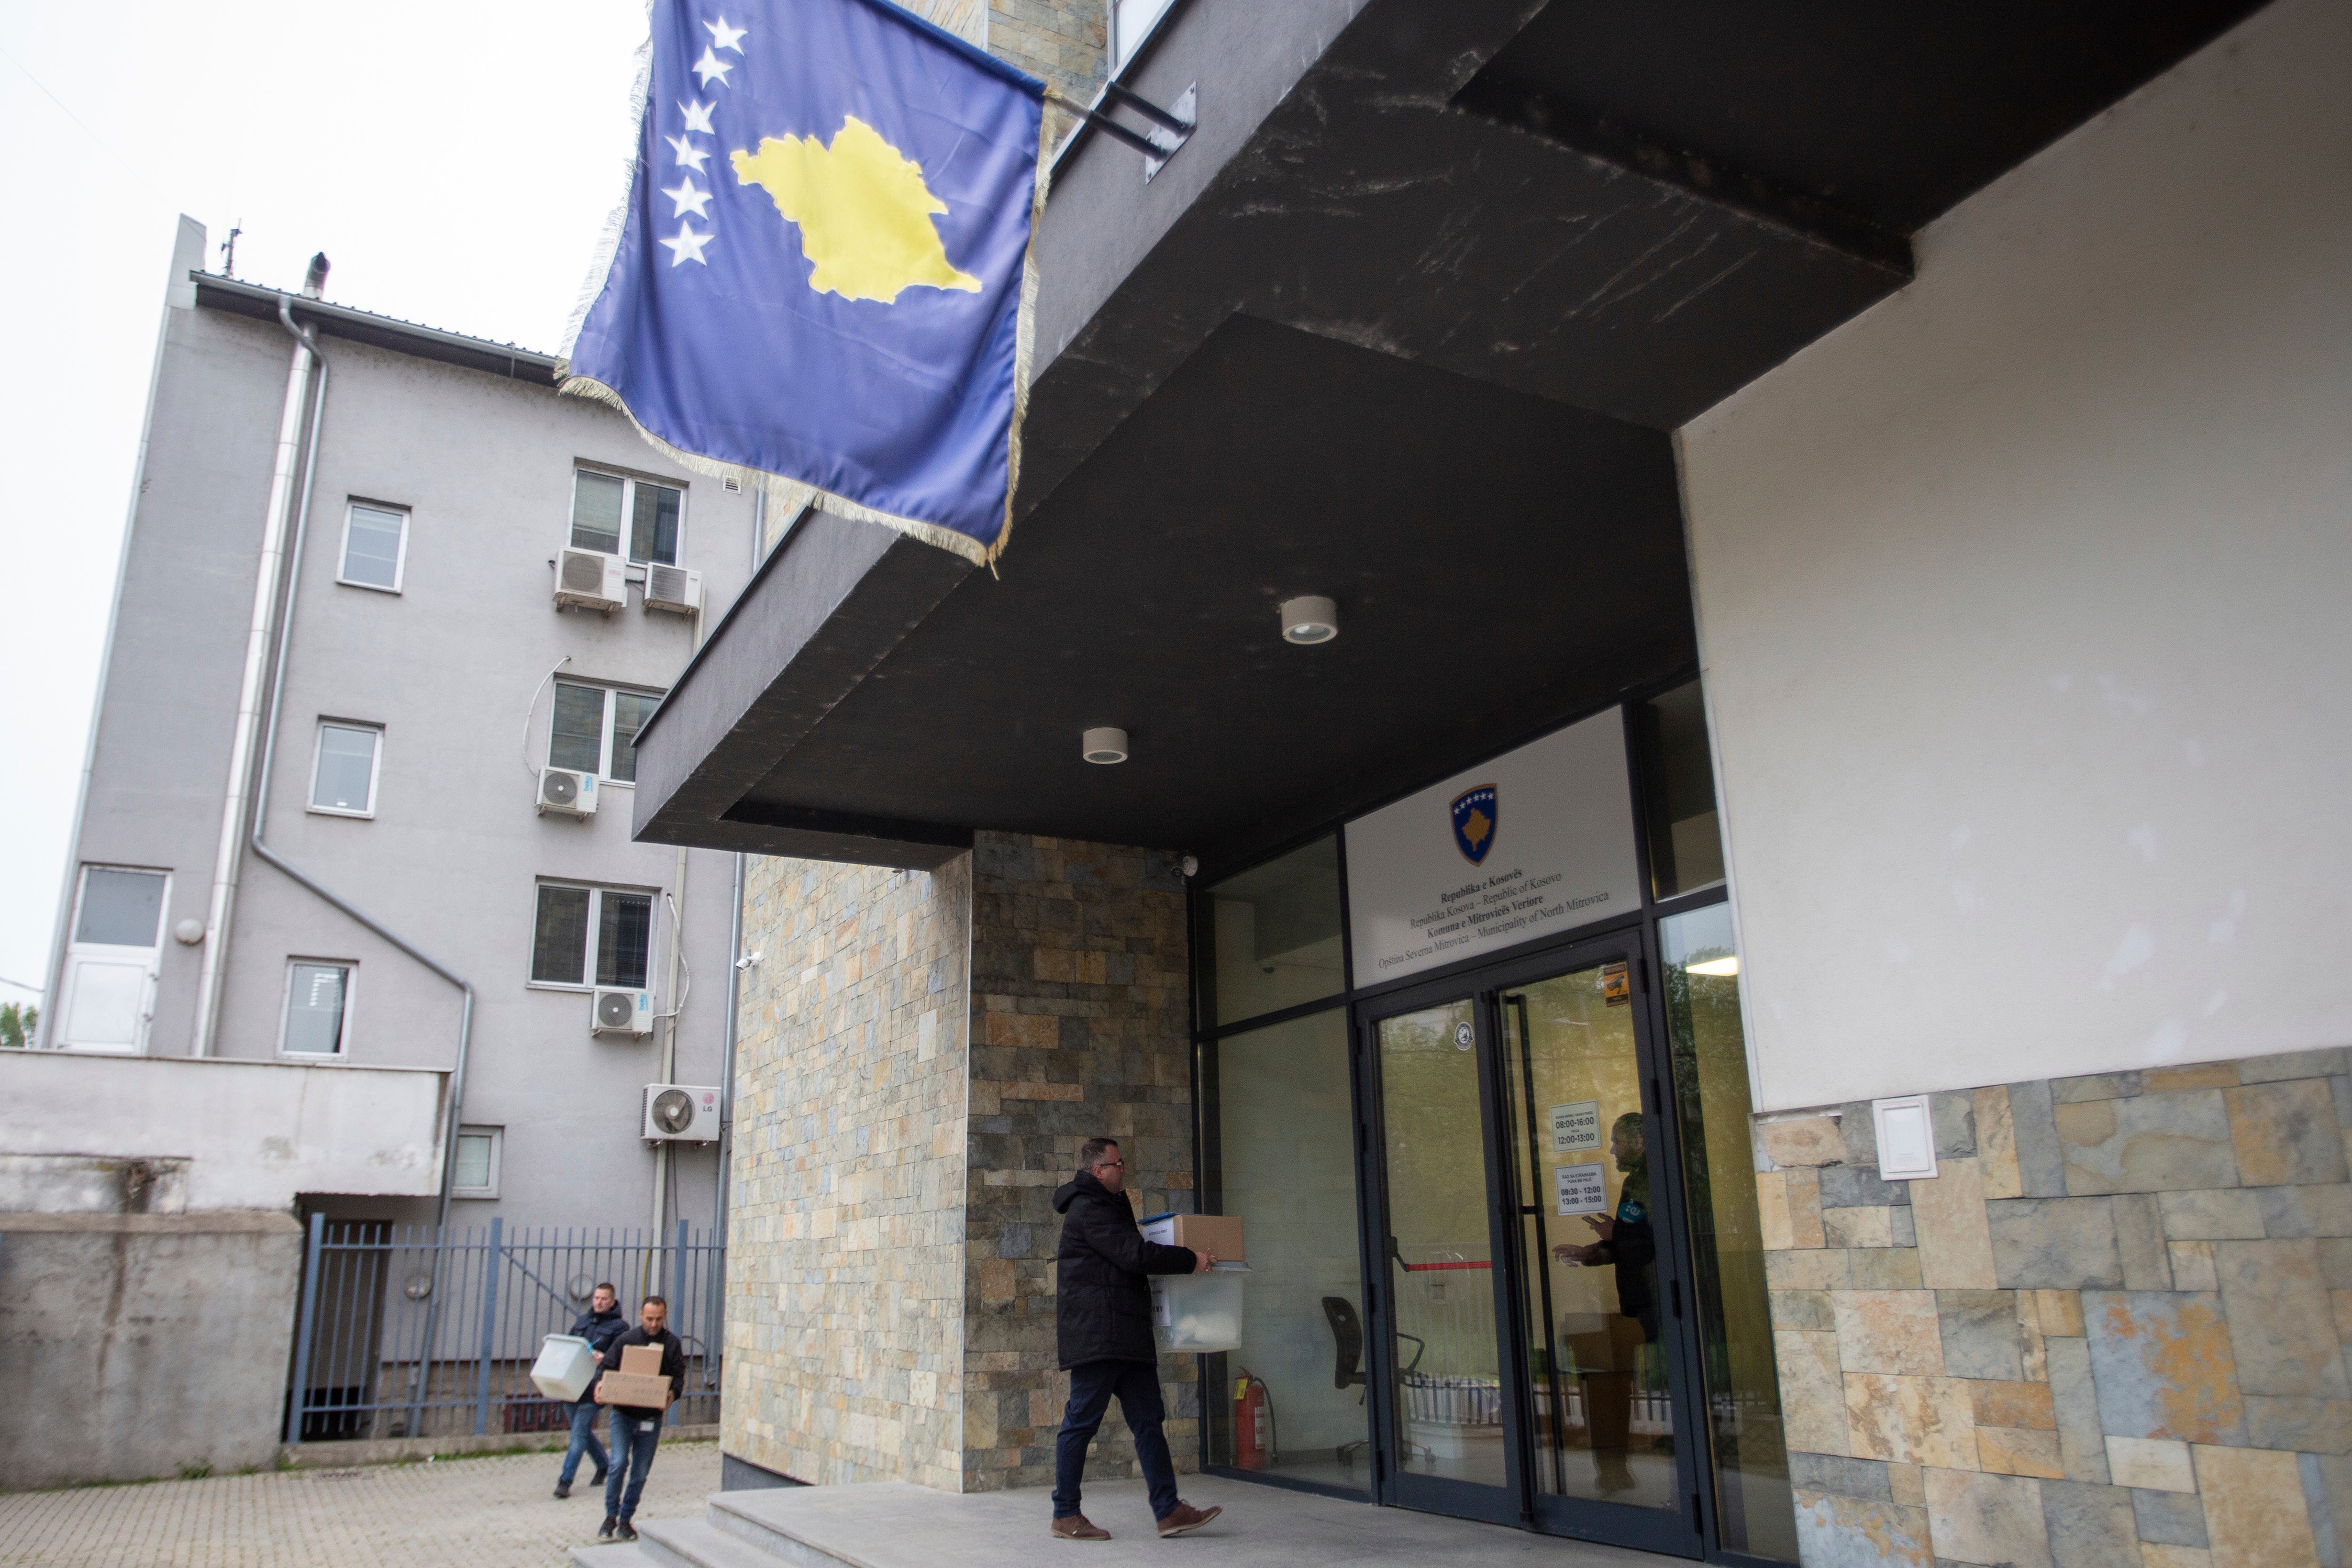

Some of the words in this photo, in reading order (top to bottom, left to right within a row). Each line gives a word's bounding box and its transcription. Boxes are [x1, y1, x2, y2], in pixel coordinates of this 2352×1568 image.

[1410, 911, 1446, 929] Republika
[1446, 902, 1474, 917] Kosova
[1483, 887, 1517, 905] Republic
[1519, 880, 1528, 893] of
[1529, 873, 1561, 890] Kosovo
[1441, 884, 1480, 903] Republika
[1489, 869, 1522, 887] Kosovës
[1378, 954, 1404, 970] Opština
[1406, 945, 1432, 960] Severna
[1434, 934, 1469, 952] Mitrovica
[1478, 916, 1526, 939] Municipality
[1529, 910, 1539, 923] of
[1540, 903, 1564, 920] North
[1566, 892, 1609, 912] Mitrovica
[1427, 921, 1459, 938] Komuna
[1468, 905, 1510, 926] Mitrovicës
[1511, 895, 1543, 911] Veriore
[1556, 1117, 1594, 1129] 08:00-16:00
[1558, 1133, 1594, 1144] 12:00-13:00
